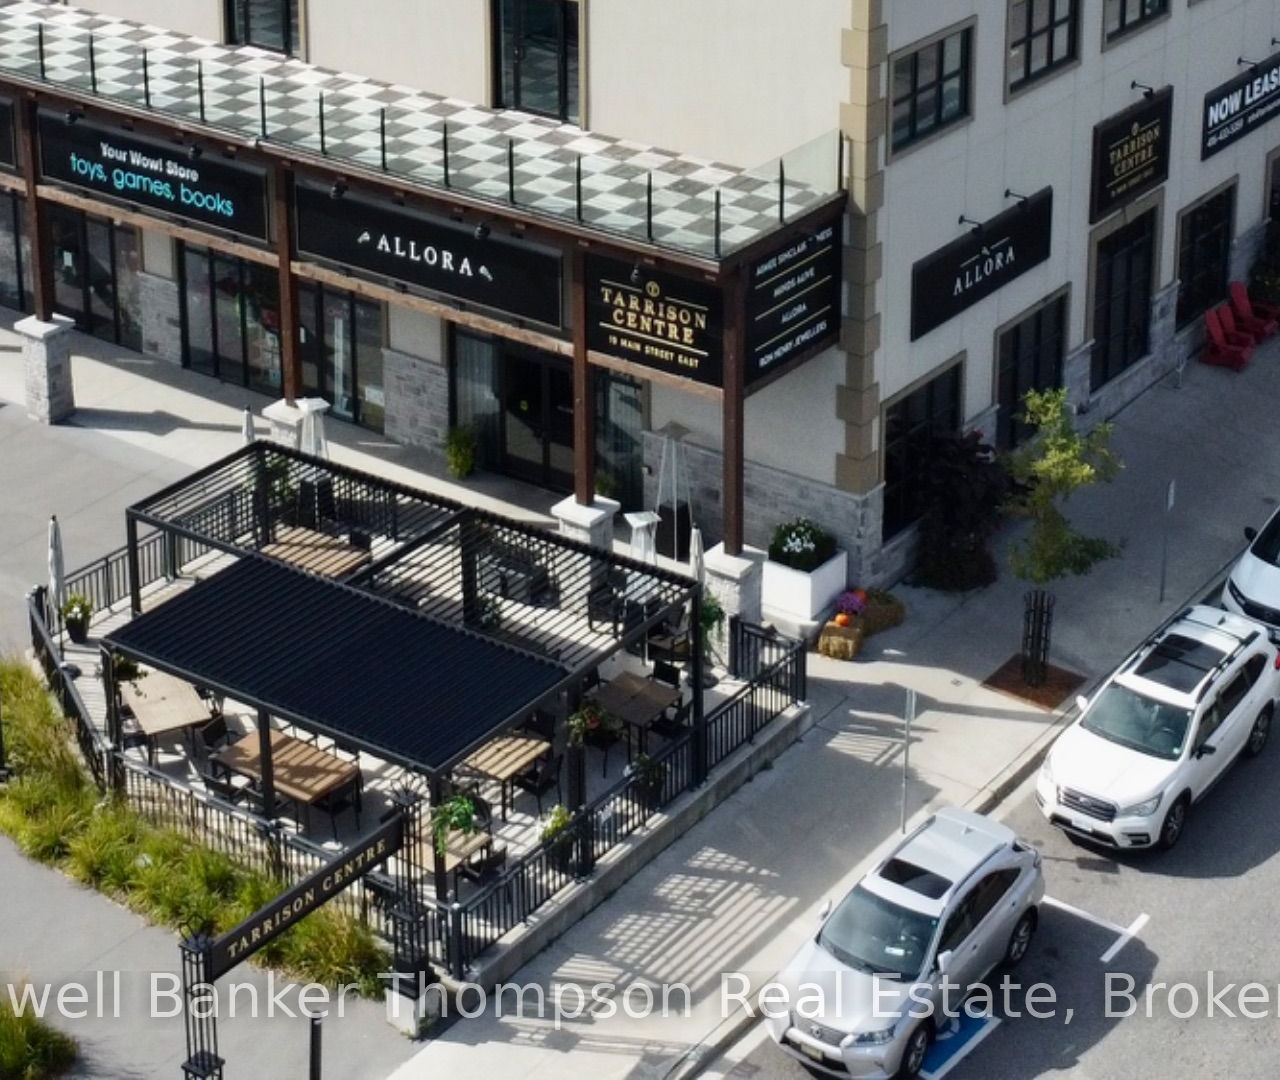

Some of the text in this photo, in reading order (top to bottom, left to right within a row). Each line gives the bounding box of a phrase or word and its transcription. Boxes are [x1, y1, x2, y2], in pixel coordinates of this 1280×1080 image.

[1208, 88, 1243, 128] NOW
[100, 142, 200, 182] Your Wow! Store
[70, 152, 234, 217] toys, games, books
[376, 233, 473, 278] ALLORA
[953, 246, 1015, 296] ALLORA
[601, 286, 707, 330] TARRISON
[612, 308, 695, 344] CENTRE
[620, 338, 641, 352] MAIN
[644, 344, 674, 361] STREET
[678, 353, 699, 369] EAST
[227, 838, 386, 958] TARRISON CENTRE
